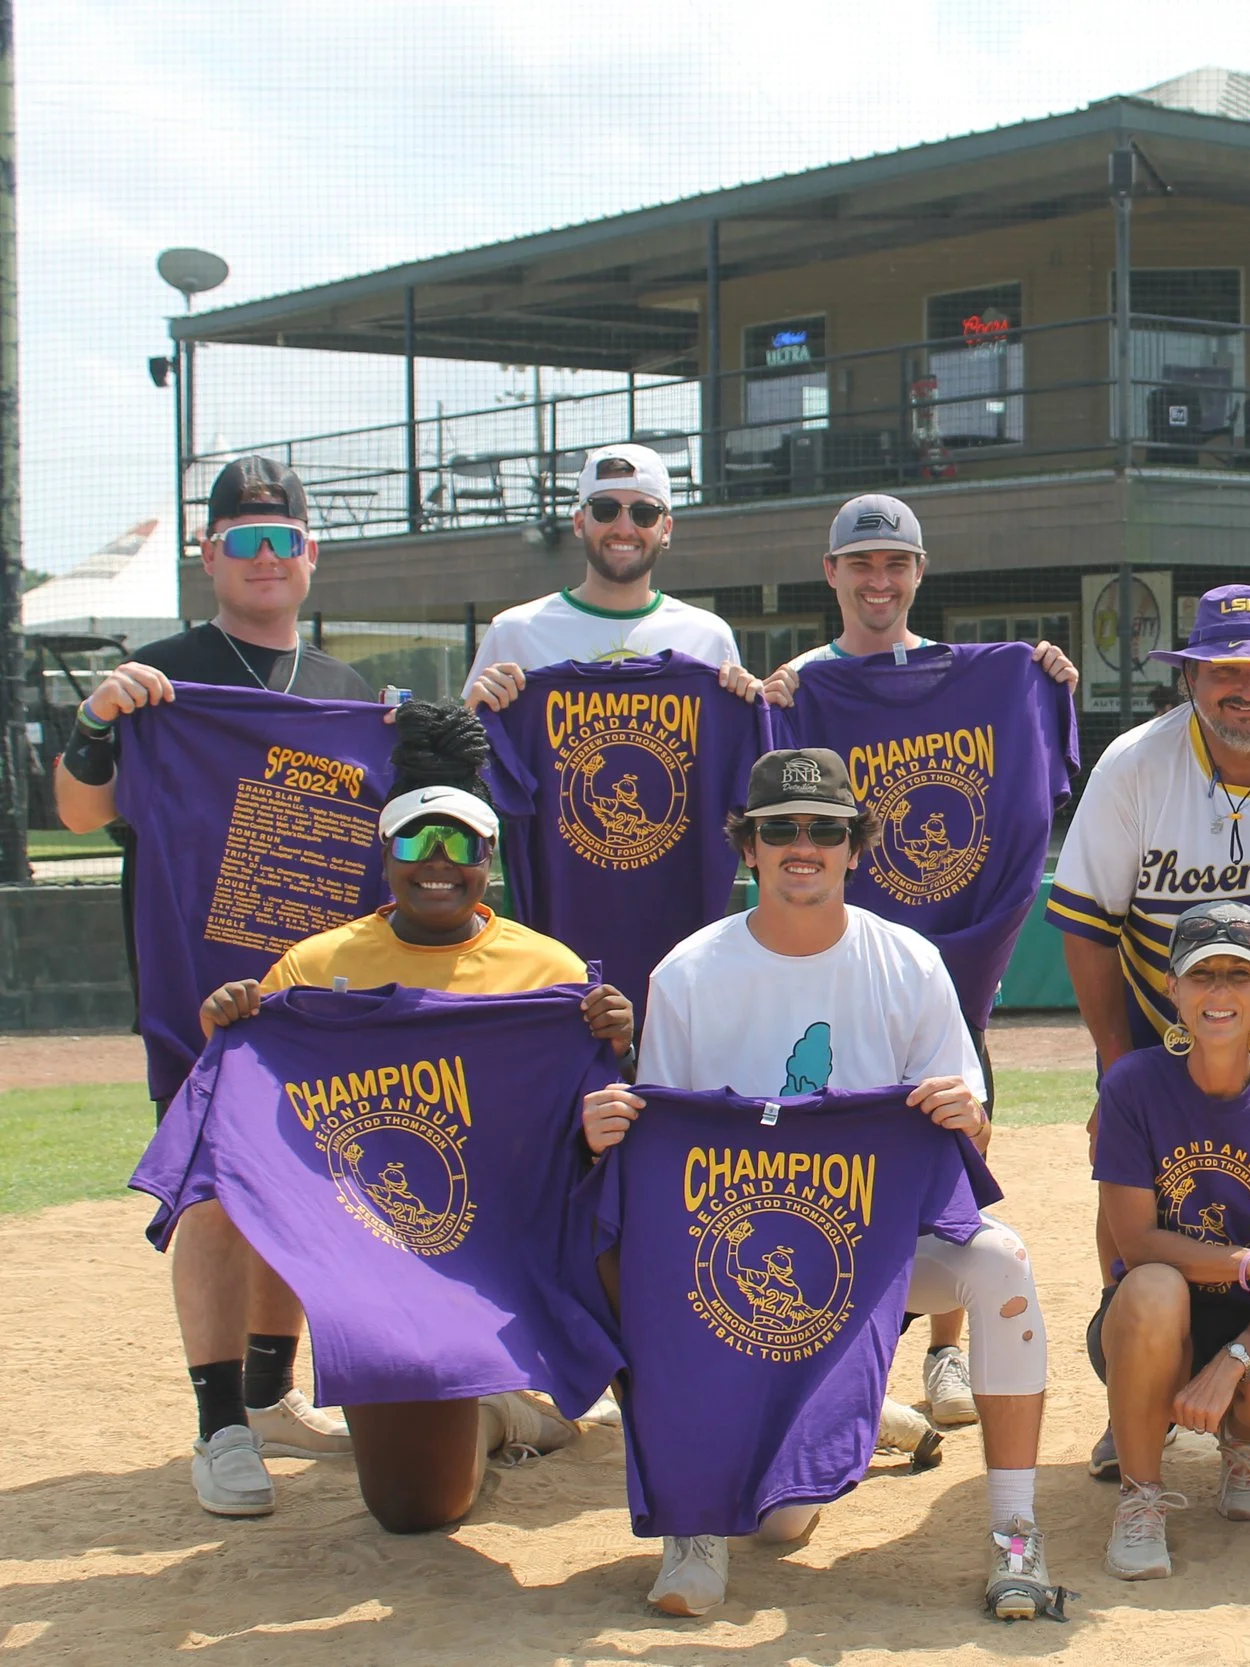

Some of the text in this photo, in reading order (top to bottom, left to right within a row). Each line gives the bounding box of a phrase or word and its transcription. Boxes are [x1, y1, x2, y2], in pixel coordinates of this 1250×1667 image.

[766, 345, 809, 367] ULTRA
[546, 690, 700, 756] CHAMPION
[554, 717, 694, 772] SECOND ANNUAL
[264, 746, 364, 799] SPONSORS
[570, 738, 603, 770] ANDREW
[629, 735, 676, 770] THOMPSON
[782, 767, 822, 783] BNB
[850, 724, 993, 802] CHAMPION
[238, 783, 300, 801] GRAND SLAM
[284, 768, 338, 795] 2024
[866, 758, 990, 809] ECOND ANNUAL
[878, 774, 976, 819] ANDREW TOD THOMPSON
[229, 826, 280, 842] HOME RUN
[557, 815, 691, 870] SOFTBALL TOURNAMENT
[570, 822, 673, 856] MEMORIAL FOUNDATION
[613, 812, 638, 835] 27
[223, 849, 260, 861] TRIPLE
[869, 835, 992, 906] SOFTBALL TOURNAMENT
[887, 847, 976, 892] MEMORIAL FOUNDATION
[217, 877, 257, 891] DOUBLE
[207, 915, 245, 928] SINGLE
[285, 1055, 471, 1131] CHAMPION
[315, 1097, 467, 1151] SECOND ANNUAL
[356, 1117, 380, 1130] TOD
[384, 1116, 448, 1150] THOMPSON
[684, 1147, 875, 1226] CHAMPION
[1162, 1159, 1197, 1189] NDREW
[1198, 1159, 1218, 1167] TOD
[336, 1195, 478, 1256] SOFTBALL TOURNAMENT
[357, 1205, 458, 1244] MEMORIAL FOUNDATION
[393, 1201, 417, 1225] 27
[688, 1180, 862, 1247] SECOND ANNUAL
[711, 1200, 842, 1245] ANDREW TOD THOMPSON
[688, 1291, 855, 1362] SOFTBALL TOURNAMENT
[710, 1299, 834, 1344] MEMORIAL FOUNDATION
[761, 1289, 794, 1319] 27
